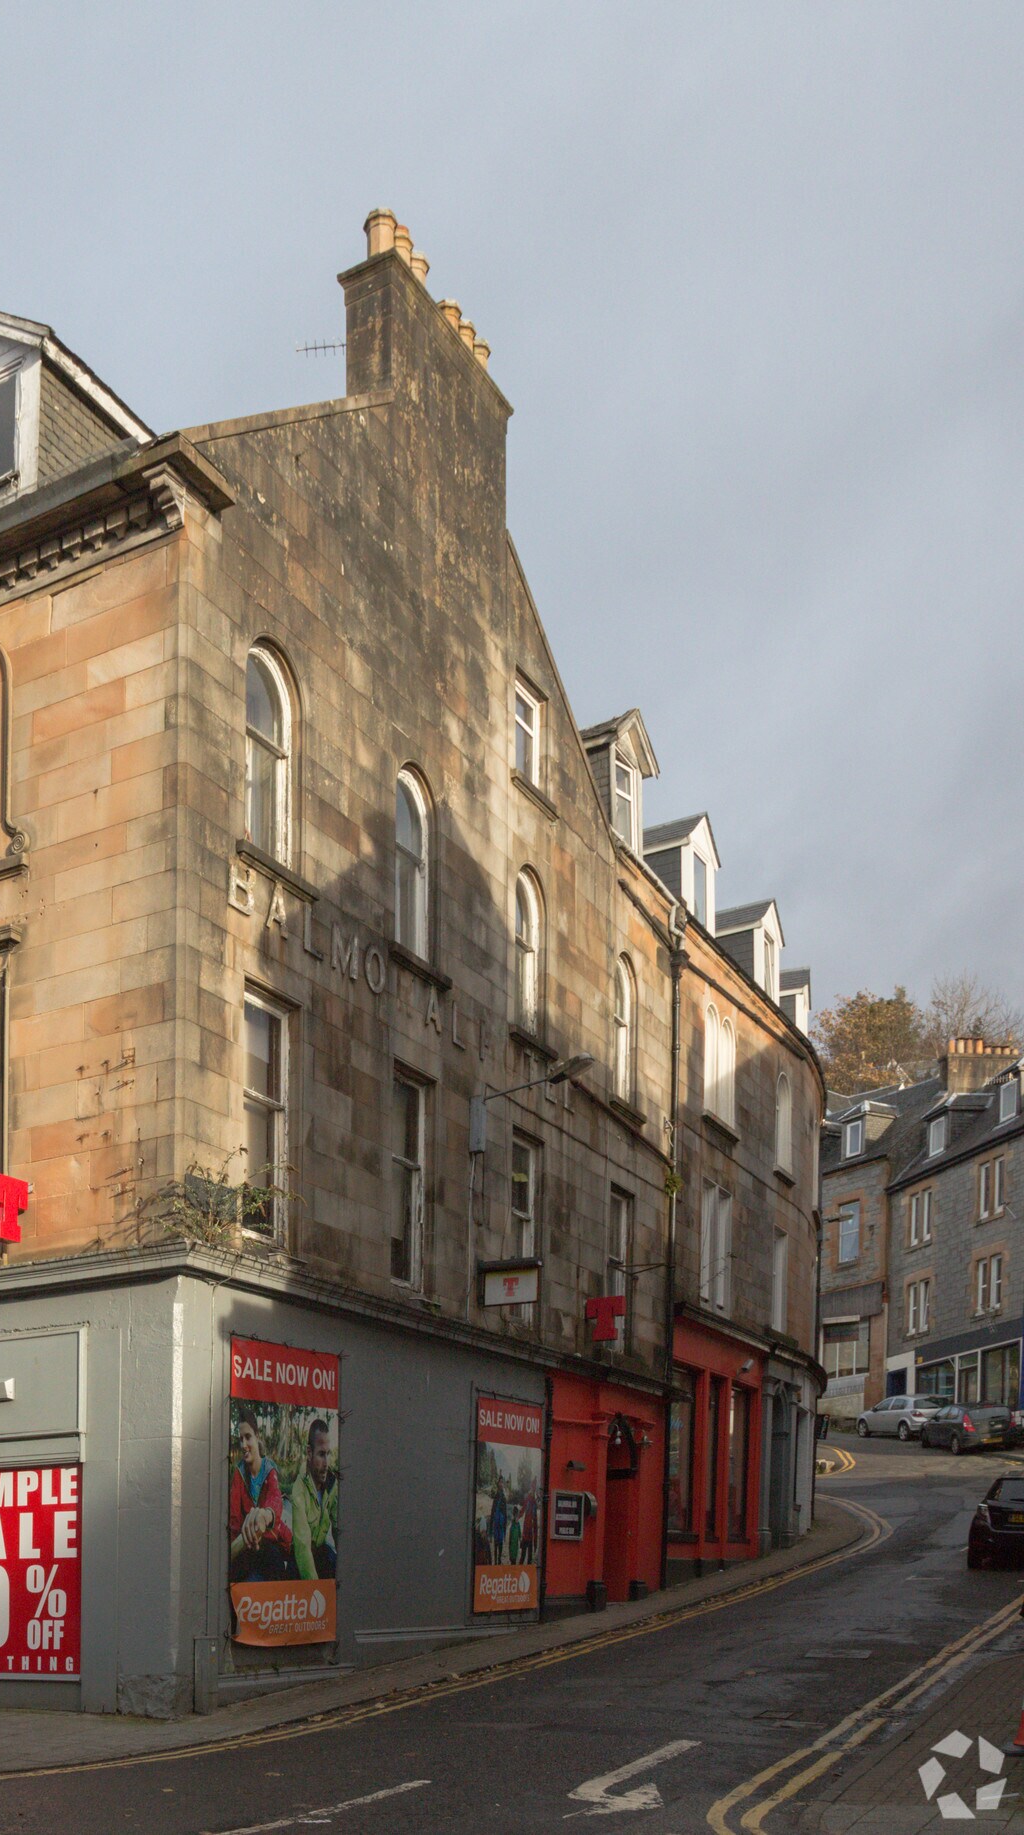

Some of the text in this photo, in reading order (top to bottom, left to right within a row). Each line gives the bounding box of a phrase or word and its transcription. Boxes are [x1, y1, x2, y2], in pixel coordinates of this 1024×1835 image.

[586, 1295, 626, 1342] T
[233, 1354, 336, 1391] SALE NOW ON!
[479, 1409, 540, 1433] SALE NOW ON!
[479, 1573, 518, 1601] Regatta
[236, 1593, 308, 1629] Regatta
[27, 1619, 65, 1650] OFF
[268, 1621, 326, 1635] GREAT OUTDOORS
